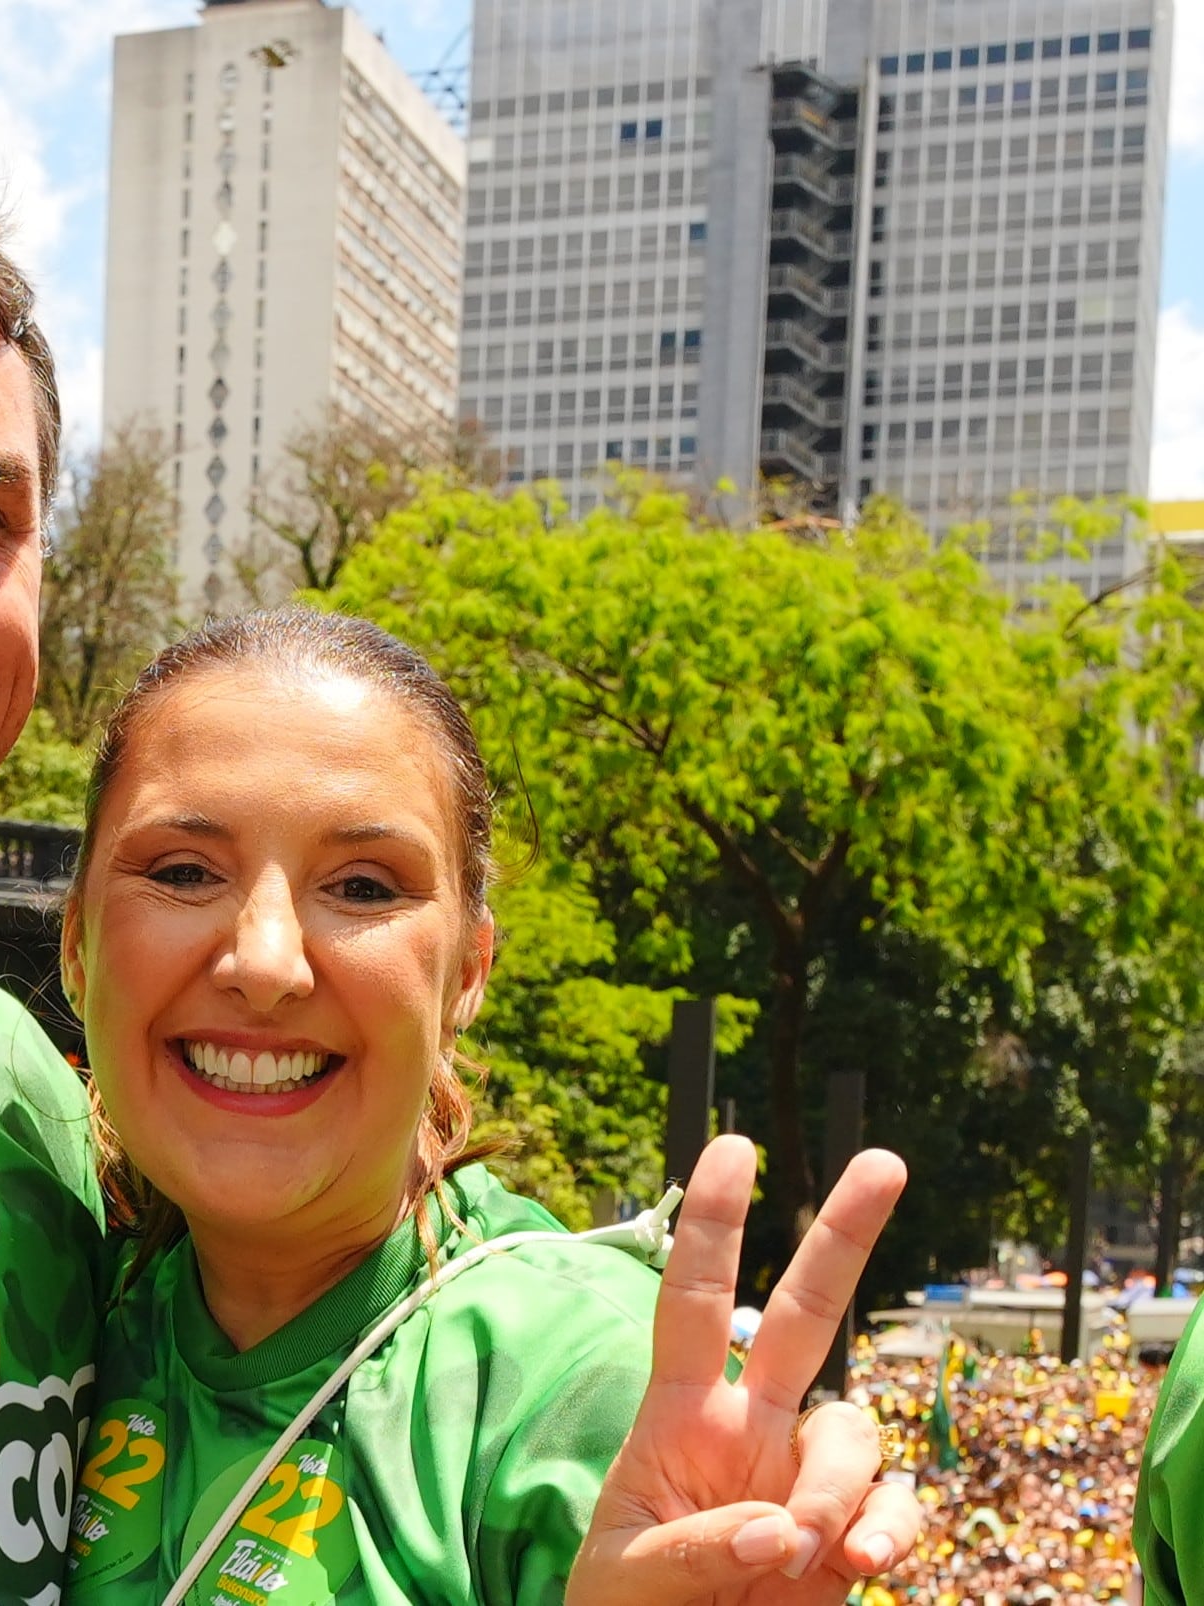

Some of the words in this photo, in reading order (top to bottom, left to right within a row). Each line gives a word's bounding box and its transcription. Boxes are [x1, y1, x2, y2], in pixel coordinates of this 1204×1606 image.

[126, 1413, 156, 1436] Vote
[81, 1419, 166, 1511] 22
[298, 1453, 328, 1475] Vote
[239, 1463, 344, 1558] 22
